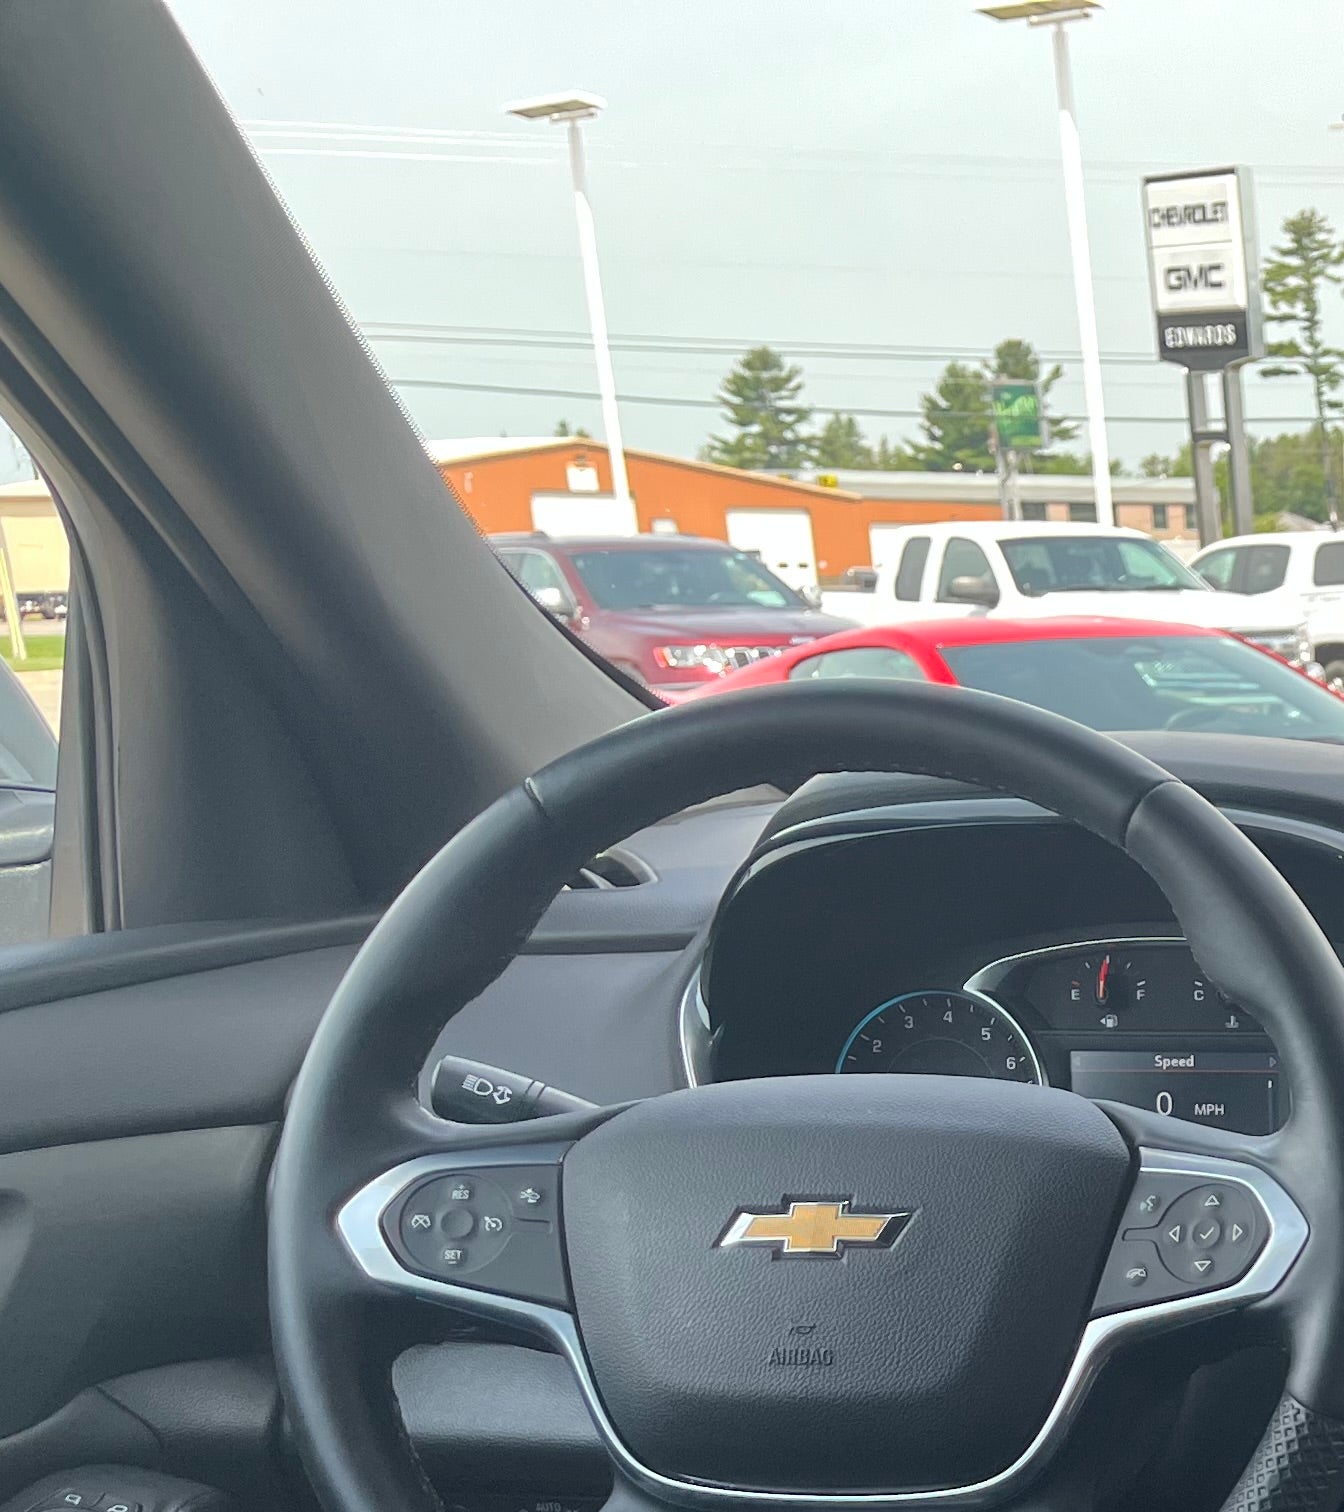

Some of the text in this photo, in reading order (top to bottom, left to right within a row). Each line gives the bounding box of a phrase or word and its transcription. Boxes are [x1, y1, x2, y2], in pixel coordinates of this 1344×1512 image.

[1149, 201, 1229, 228] CHEVROLET
[1165, 262, 1225, 290] GMC
[1165, 323, 1237, 348] EDWARDS
[1071, 989, 1080, 1000] E
[1136, 989, 1146, 1000] F
[1193, 989, 1205, 1001] C
[904, 1016, 914, 1029] 3
[942, 1011, 953, 1023] 4
[981, 1028, 991, 1041] 5
[872, 1040, 882, 1053] 2
[1006, 1057, 1016, 1070] 6
[1154, 1055, 1195, 1070] Speed
[1155, 1092, 1225, 1116] 0 MPH
[451, 1188, 470, 1200] RES
[444, 1250, 463, 1260] SET
[768, 1347, 834, 1367] AIRBAG
